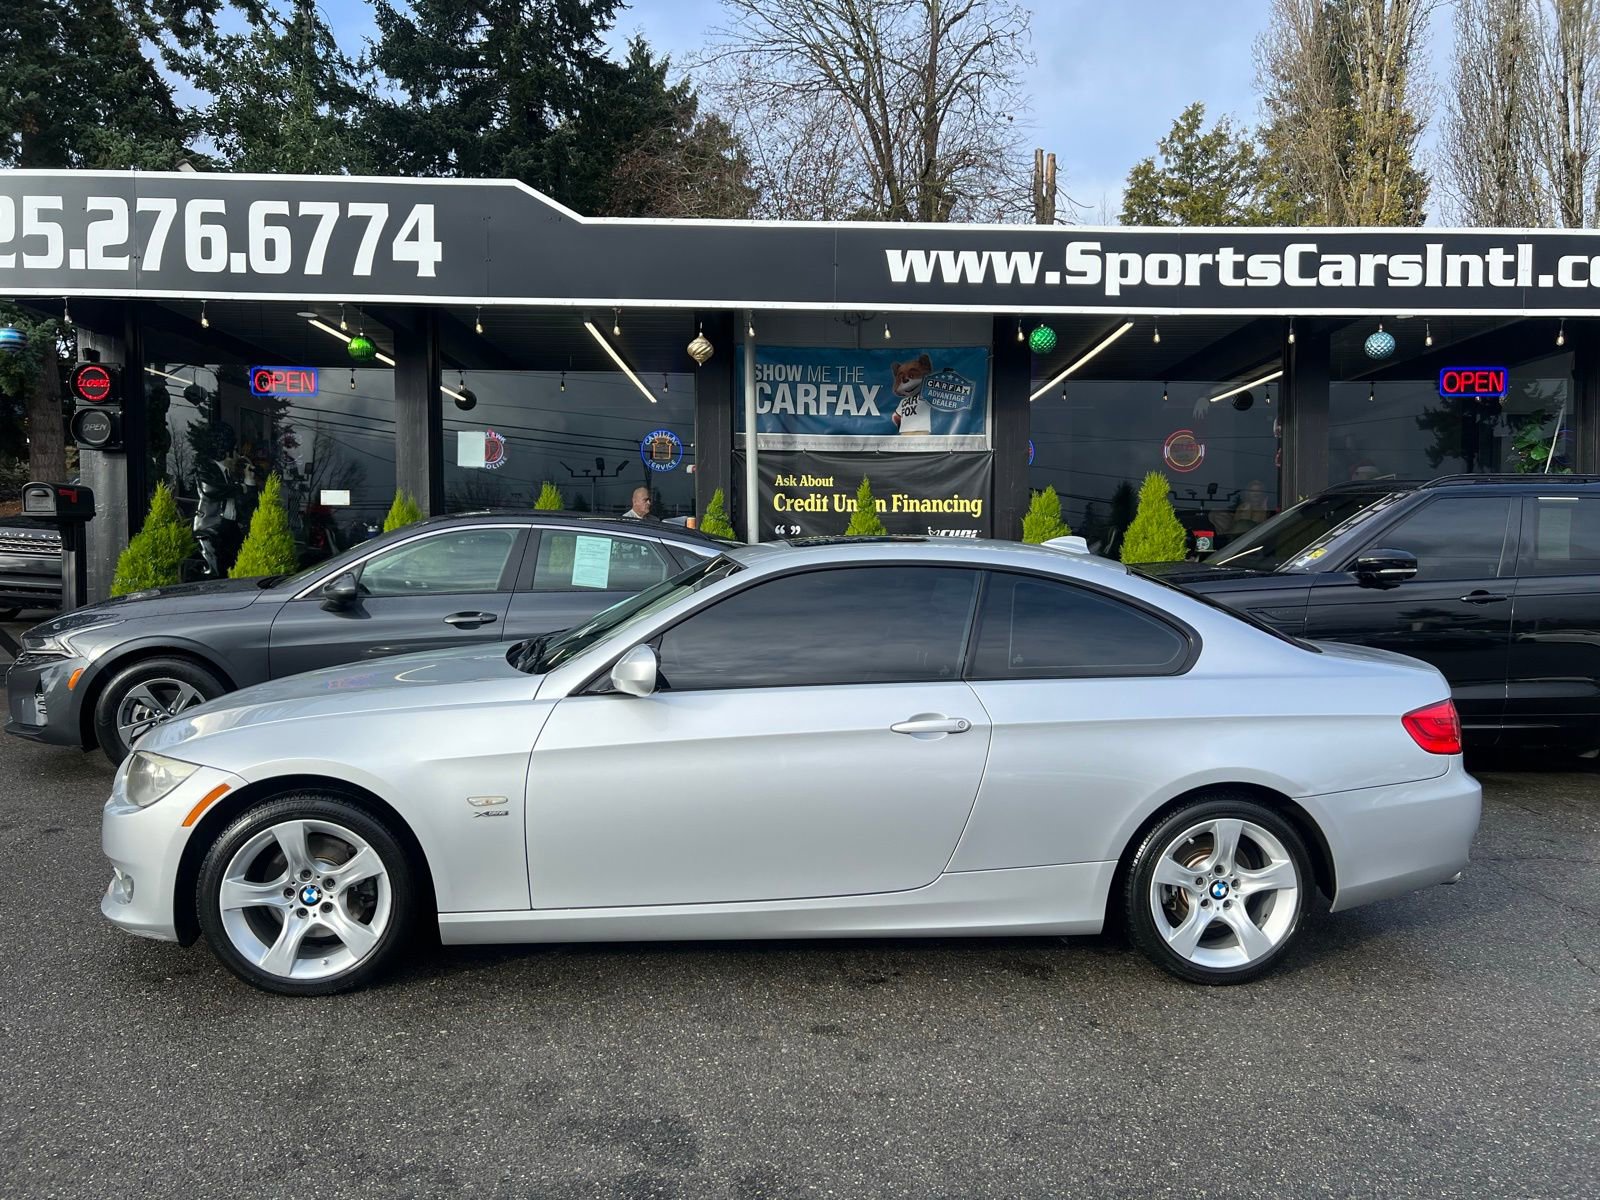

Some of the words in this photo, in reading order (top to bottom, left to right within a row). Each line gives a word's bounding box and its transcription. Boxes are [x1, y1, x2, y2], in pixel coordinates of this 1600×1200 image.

[254, 370, 315, 393] OPEN
[807, 365, 831, 383] ME
[835, 366, 865, 383] THE
[927, 380, 971, 395] CARFAX
[1443, 371, 1504, 393] OPEN
[756, 382, 881, 416] CARFAX
[927, 389, 965, 403] ADVANTAGE
[931, 398, 958, 409] DEALER
[901, 405, 918, 417] FOX
[83, 423, 107, 432] OPEN
[644, 430, 680, 446] CADILLAC
[648, 459, 677, 470] SERVICE
[774, 474, 797, 487] Ask
[799, 474, 834, 487] About
[773, 493, 829, 512] Credit
[833, 494, 888, 512] Unn
[891, 494, 983, 518] Financing
